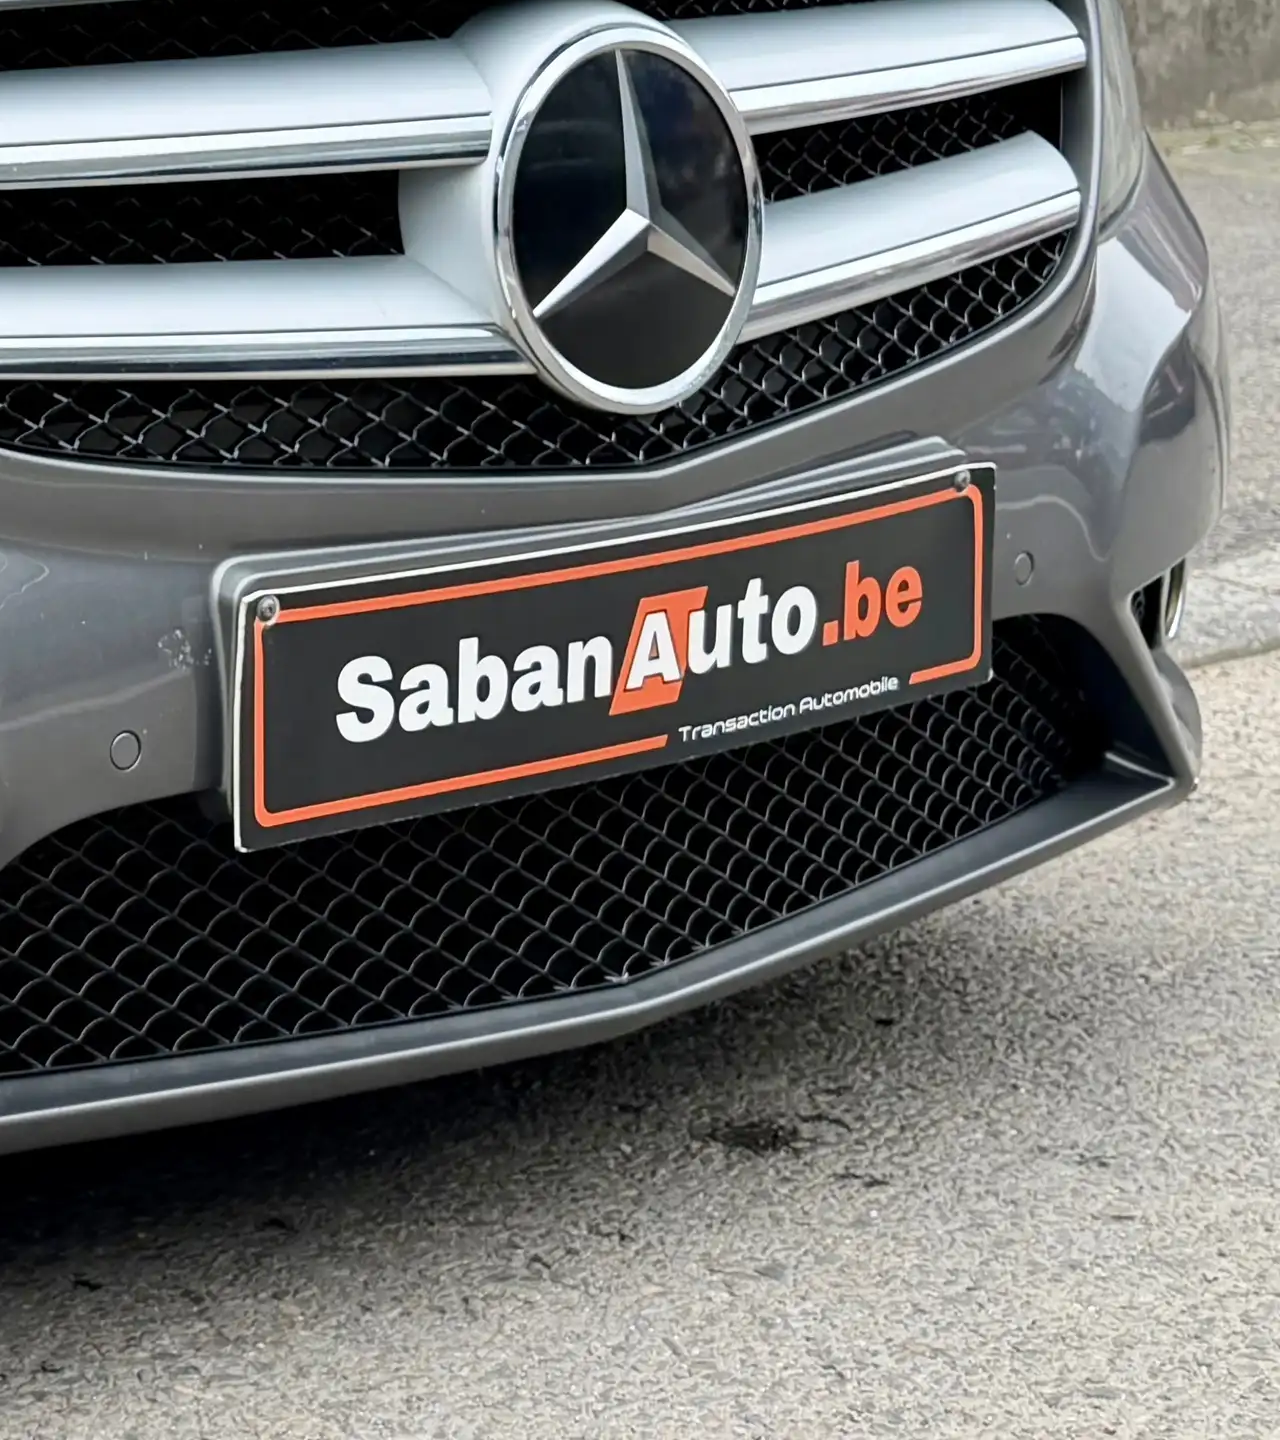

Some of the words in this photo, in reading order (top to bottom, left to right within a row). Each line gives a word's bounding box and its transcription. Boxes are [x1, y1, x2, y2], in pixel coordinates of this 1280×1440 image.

[333, 560, 923, 744] SabanAuto.be
[678, 703, 797, 744] Transaction
[799, 674, 900, 715] Automobile
